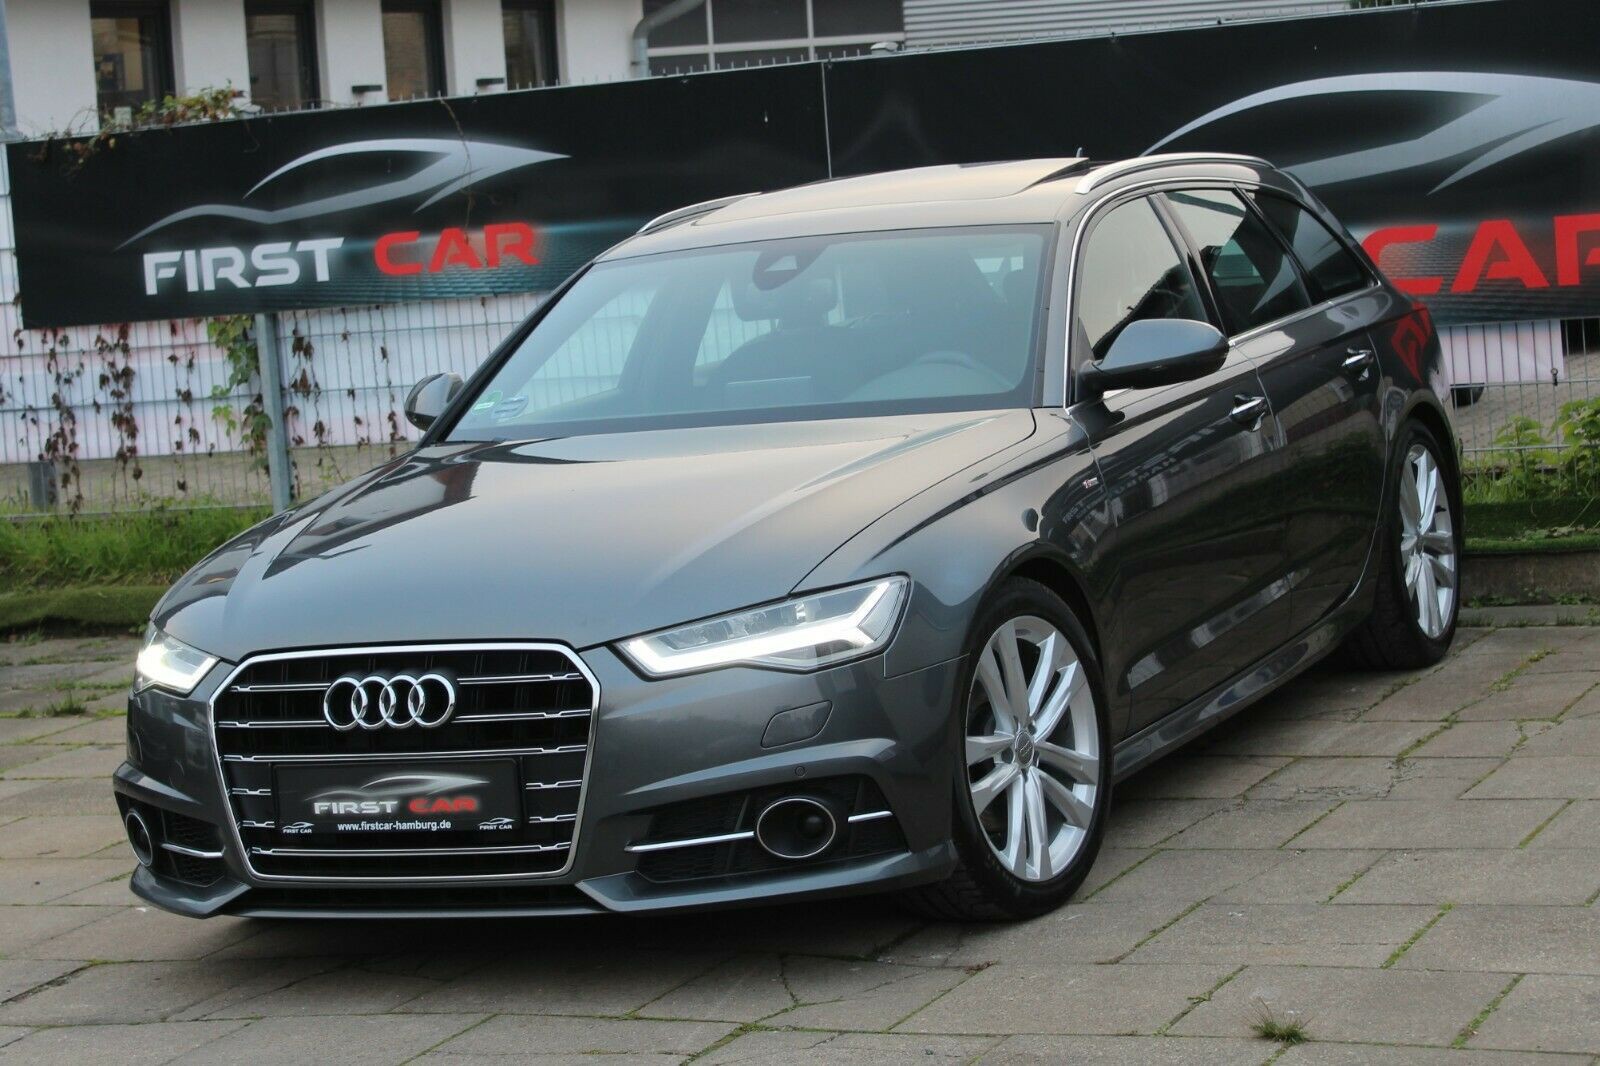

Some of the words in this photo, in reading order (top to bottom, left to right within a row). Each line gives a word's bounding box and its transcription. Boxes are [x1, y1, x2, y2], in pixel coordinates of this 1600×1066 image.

[143, 237, 344, 295] FIRST
[374, 222, 540, 276] CAR
[314, 801, 398, 814] FIRST
[409, 797, 476, 812] CAR
[337, 820, 452, 832] www.firstcar-hamburg.de
